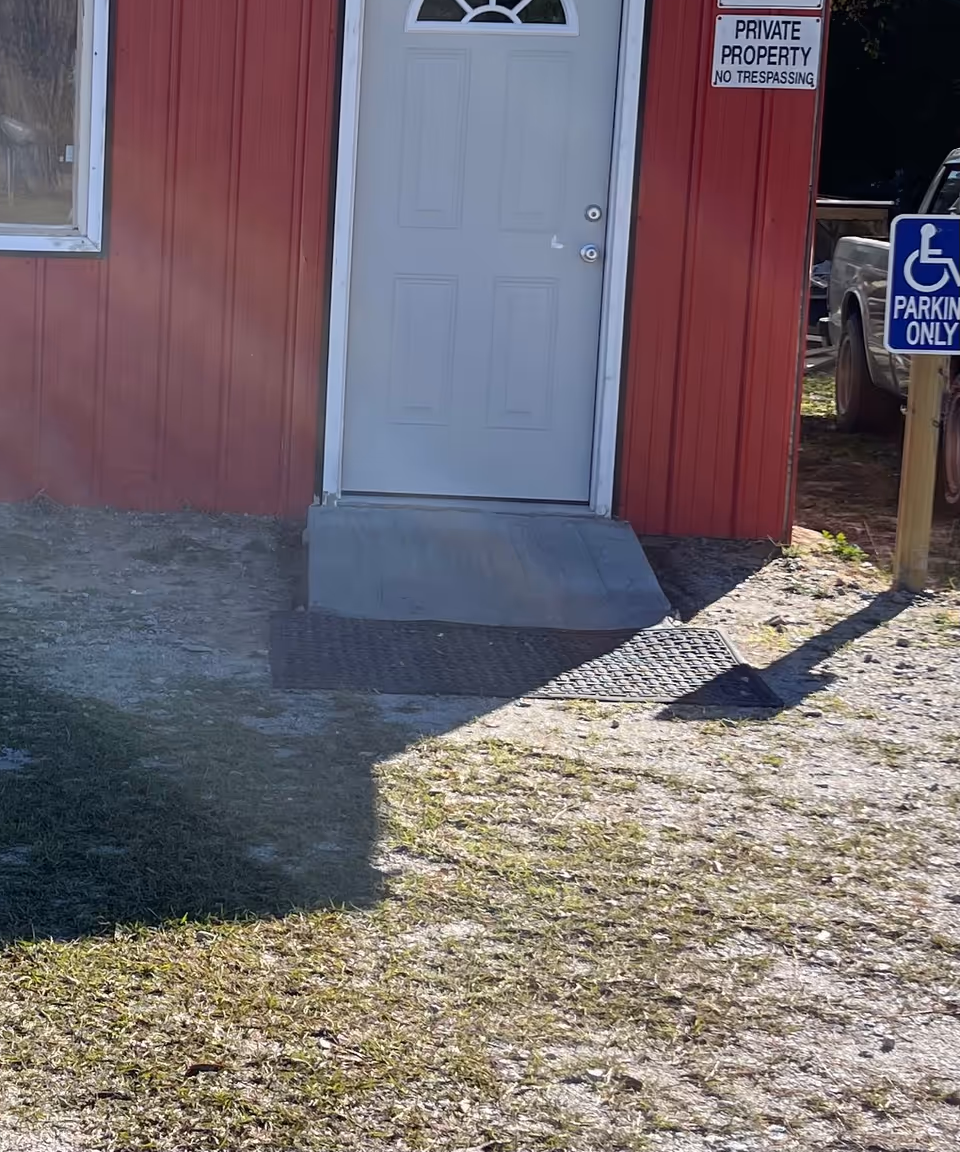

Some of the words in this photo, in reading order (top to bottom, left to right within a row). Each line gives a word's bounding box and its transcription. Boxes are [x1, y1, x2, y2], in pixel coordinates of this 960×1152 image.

[735, 19, 802, 41] PRIVATE
[721, 45, 812, 67] PROPERTY
[714, 70, 732, 83] NO
[737, 70, 815, 85] TRESPASSING
[906, 320, 959, 346] ONLY
